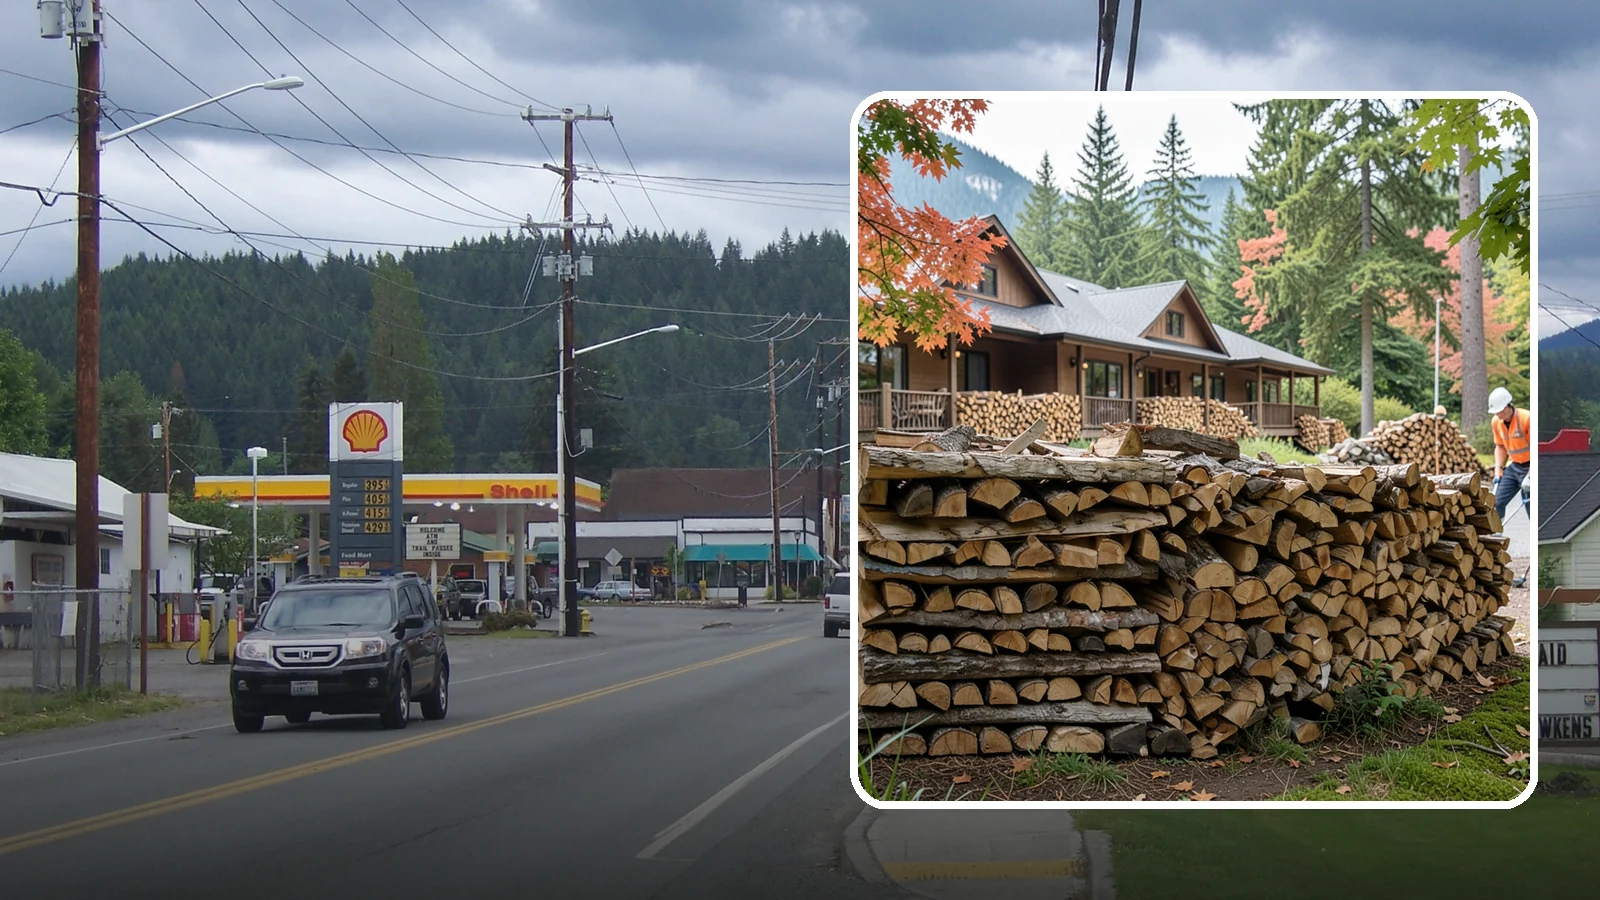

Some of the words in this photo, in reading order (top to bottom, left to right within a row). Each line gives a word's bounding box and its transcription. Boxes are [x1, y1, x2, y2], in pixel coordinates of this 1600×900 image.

[366, 480, 384, 490] 395
[490, 484, 547, 498] Shell
[366, 494, 384, 504] 405
[366, 508, 384, 518] 415
[366, 522, 384, 532] 429
[1538, 643, 1567, 666] AID
[1538, 716, 1592, 738] WKENS
